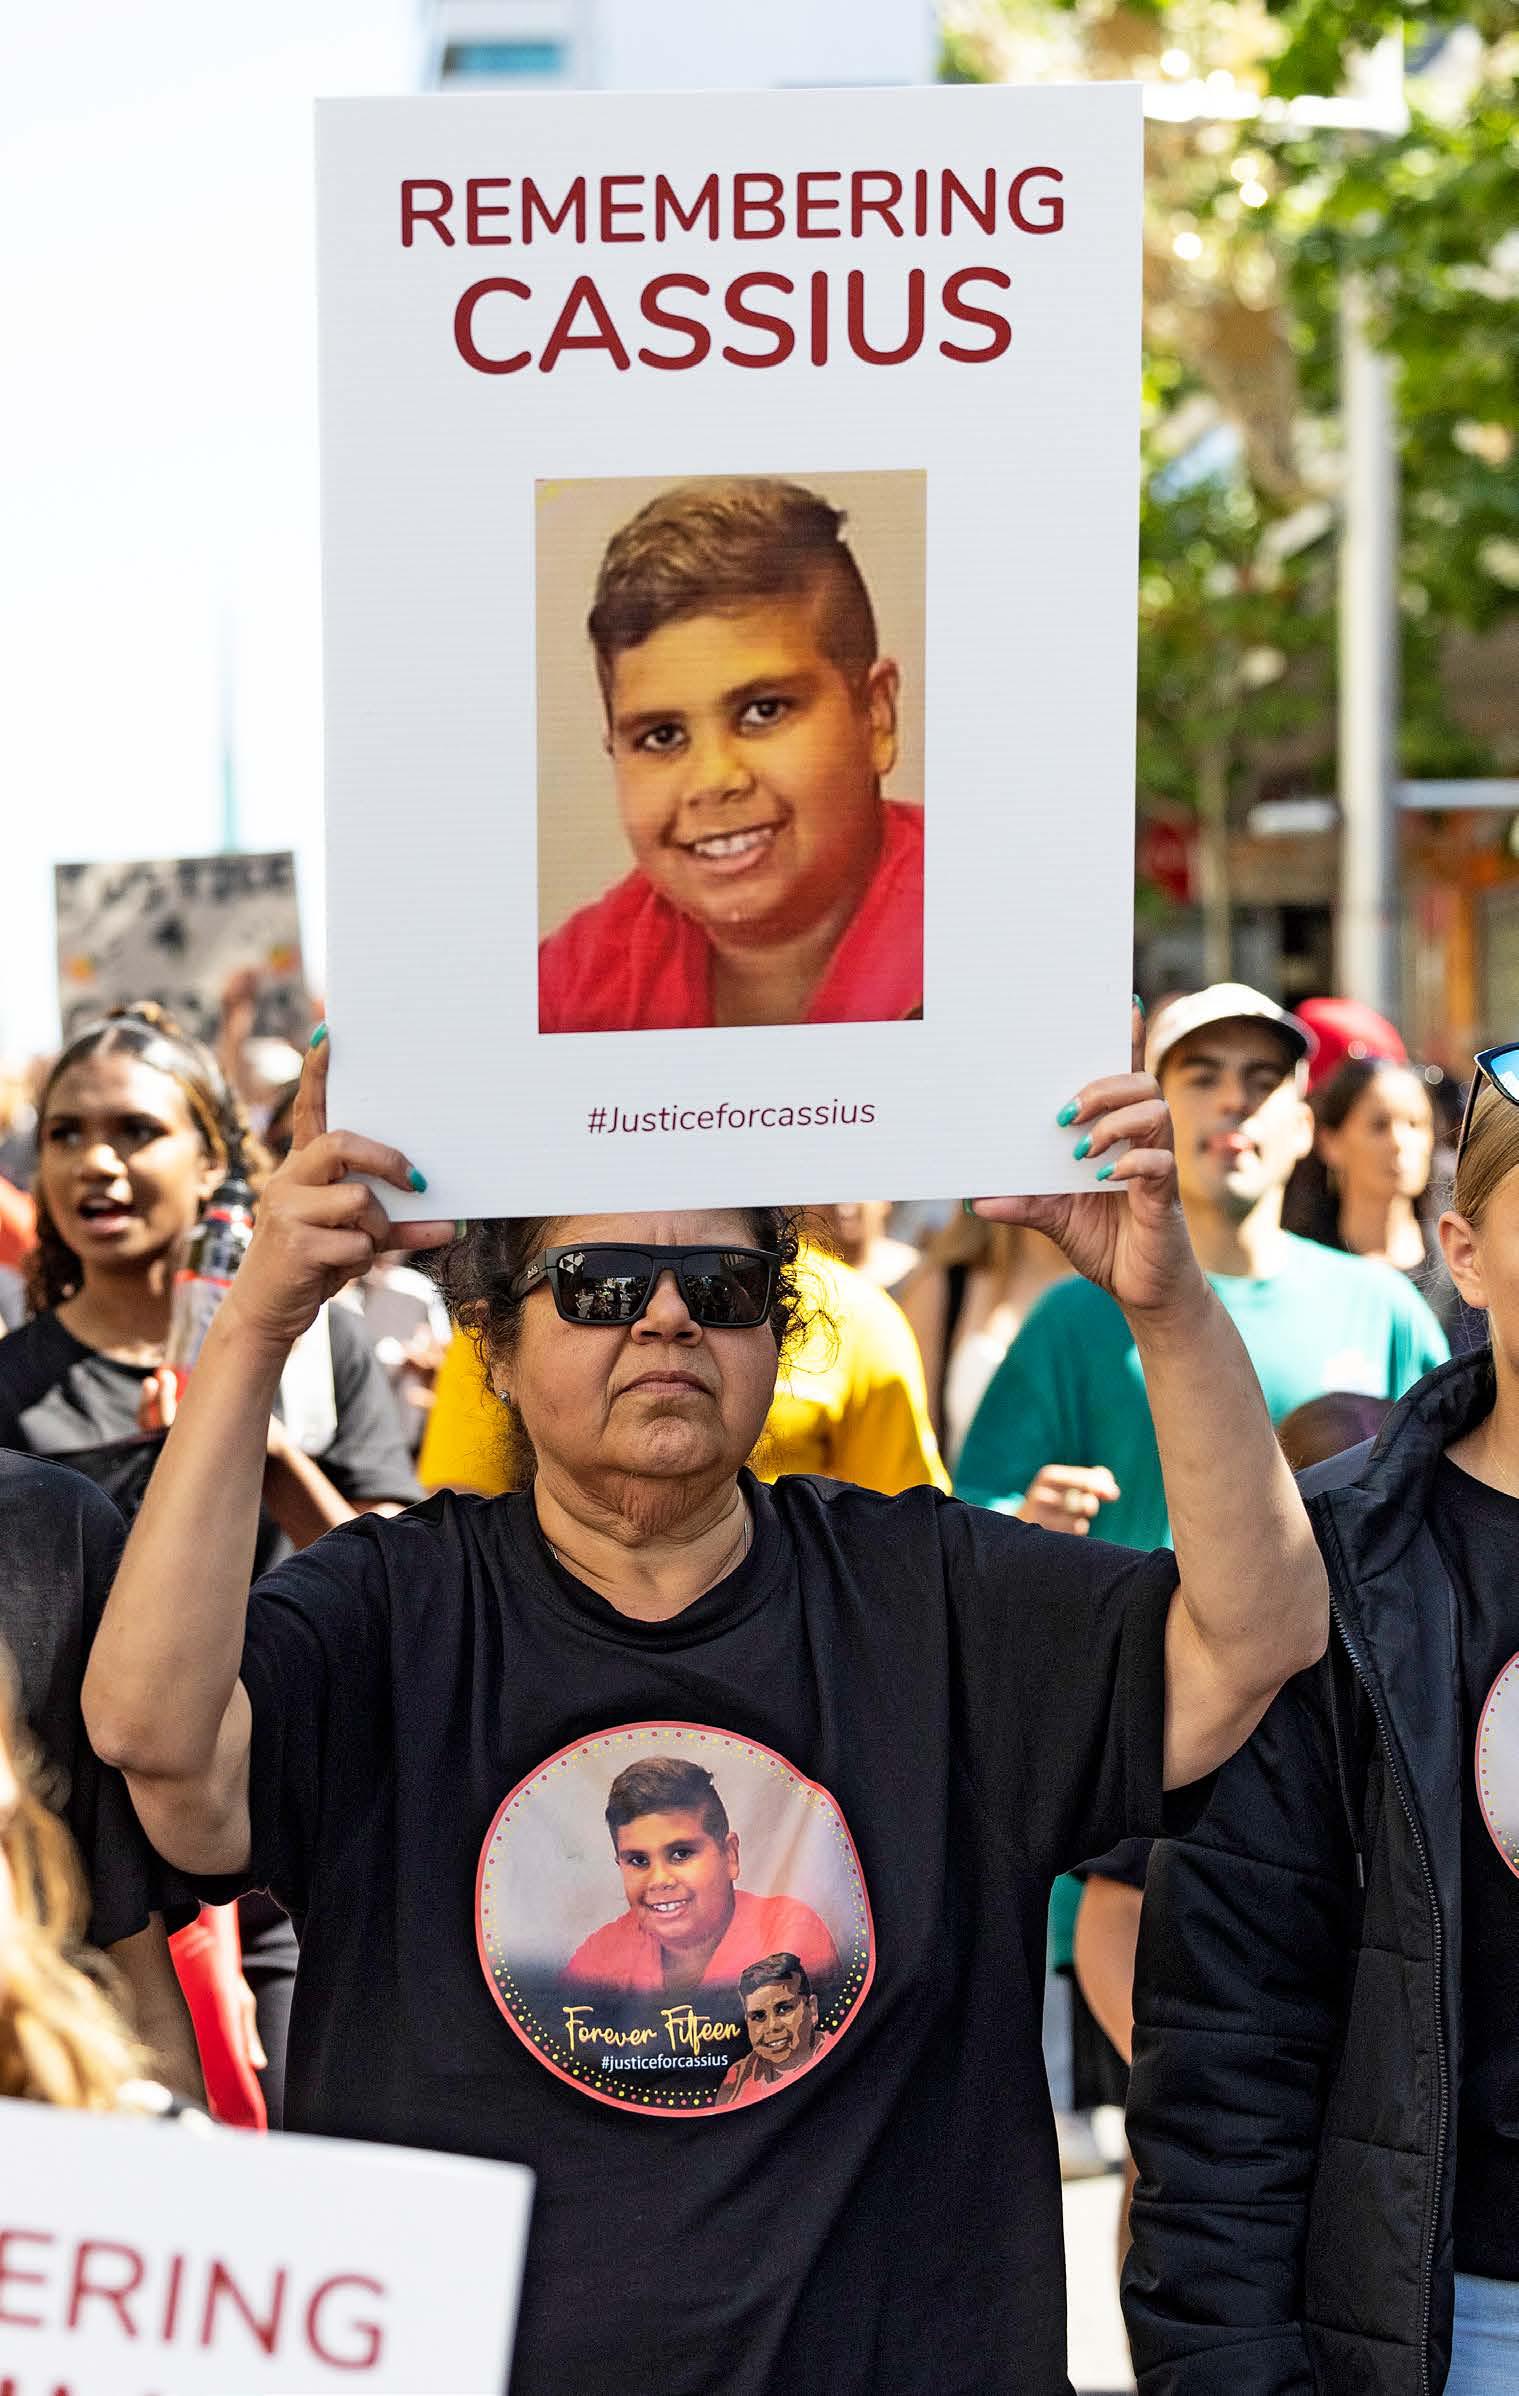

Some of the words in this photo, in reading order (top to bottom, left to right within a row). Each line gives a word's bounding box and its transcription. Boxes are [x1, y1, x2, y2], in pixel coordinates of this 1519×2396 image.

[401, 165, 1066, 249] REMEMBERING
[453, 266, 1015, 376] CASSIUS
[588, 1098, 876, 1134] #Justiceforcassius
[562, 2005, 658, 2051] Forever
[660, 2004, 741, 2057] Fifteen
[601, 2053, 729, 2073] #justiceforcassius
